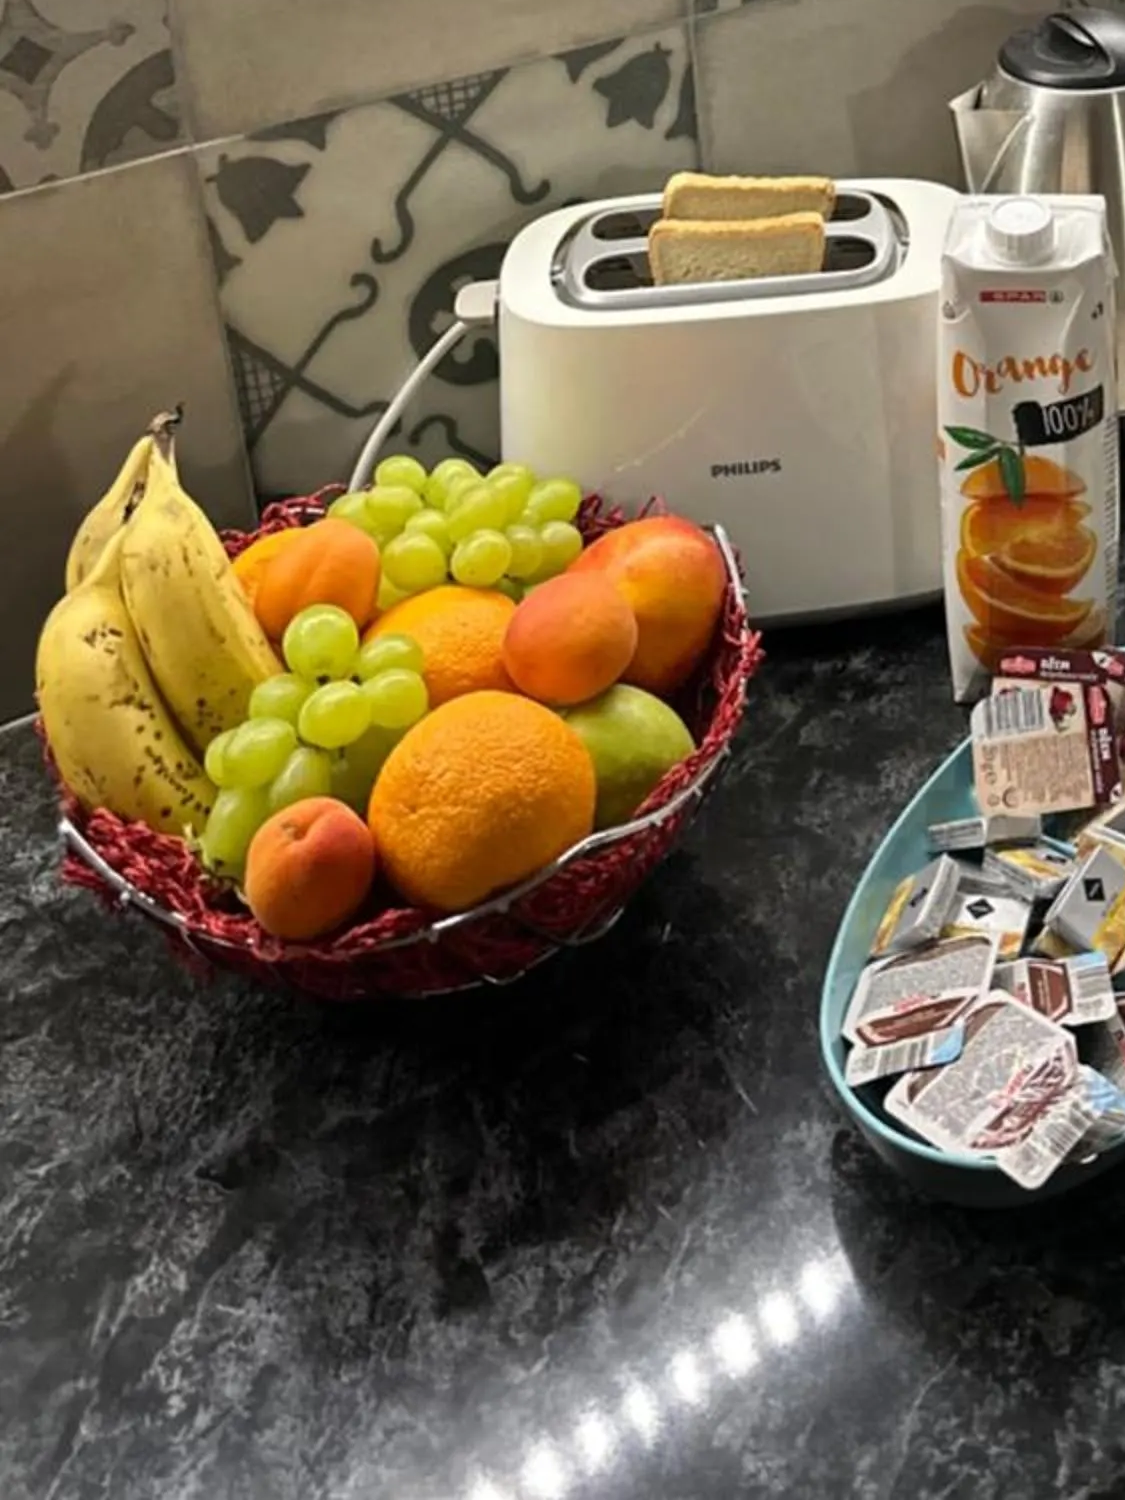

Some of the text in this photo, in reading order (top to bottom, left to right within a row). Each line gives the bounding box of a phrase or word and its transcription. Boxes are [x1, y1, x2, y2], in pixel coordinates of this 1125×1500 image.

[951, 349, 1093, 398] Orange
[1040, 397, 1096, 437] 100%
[710, 458, 783, 478] PHILIPS
